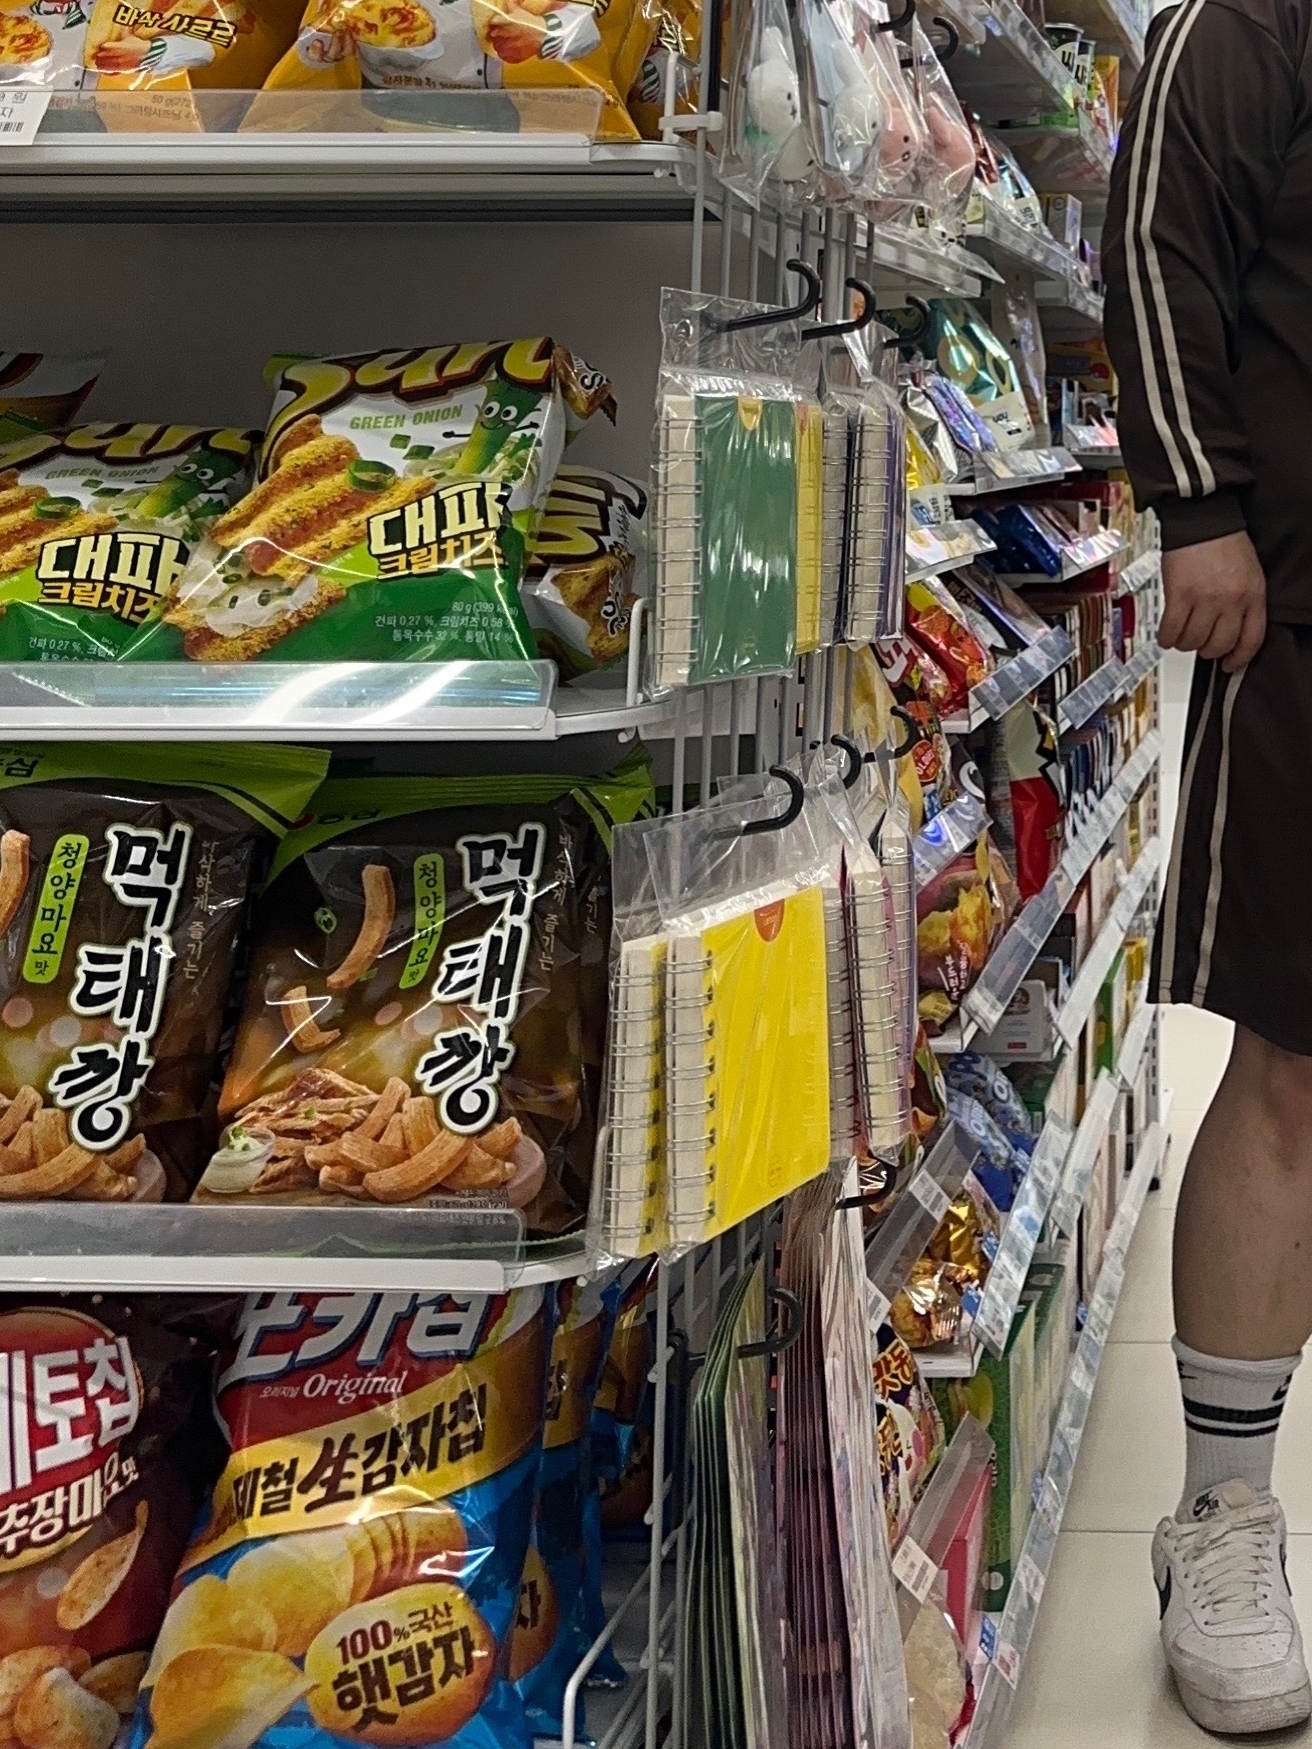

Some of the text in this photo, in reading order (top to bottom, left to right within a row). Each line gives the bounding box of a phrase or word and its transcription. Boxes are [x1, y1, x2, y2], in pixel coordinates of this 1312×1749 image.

[115, 5, 239, 48] 바삭 사르르
[349, 403, 463, 432] GREEN ONION
[46, 462, 161, 481] GREEN ONION
[368, 482, 509, 558] 대파
[37, 533, 188, 587] 대파
[377, 538, 509, 583] 크림치즈
[0, 756, 44, 780] 심
[50, 822, 194, 1151] 먹태깡
[417, 821, 545, 1134] 먹태깡
[302, 1368, 406, 1406] Original
[331, 1620, 480, 1731] 햇감자
